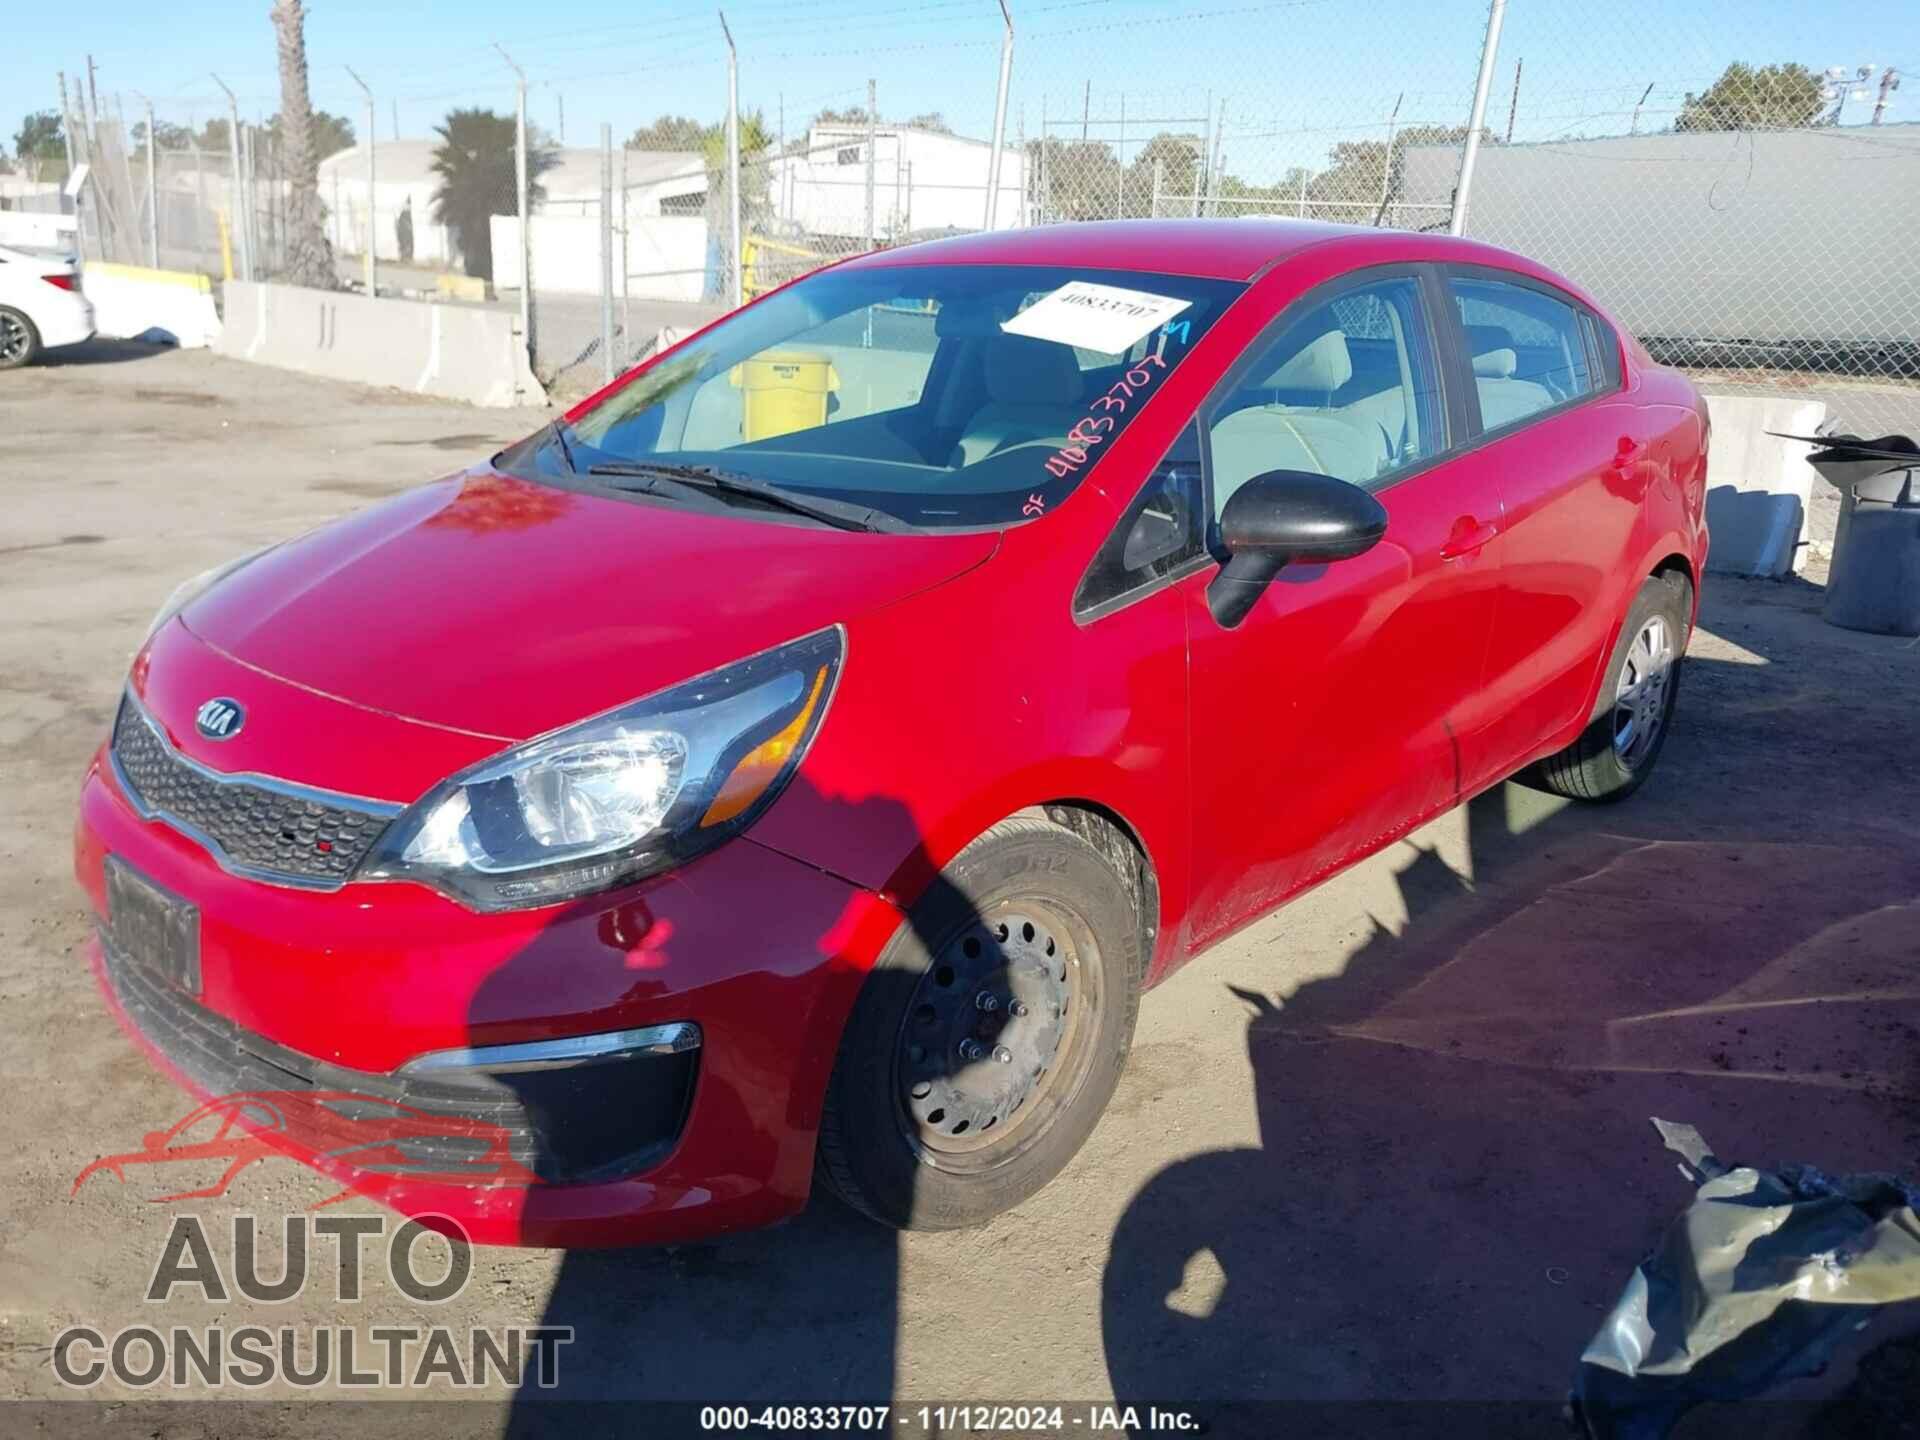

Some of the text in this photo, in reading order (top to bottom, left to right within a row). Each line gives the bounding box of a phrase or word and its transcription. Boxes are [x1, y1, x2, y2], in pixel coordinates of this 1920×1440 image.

[1060, 293, 1160, 318] 40833707
[1022, 493, 1046, 516] SF
[1044, 354, 1167, 477] 40833707
[199, 702, 236, 734] KIA
